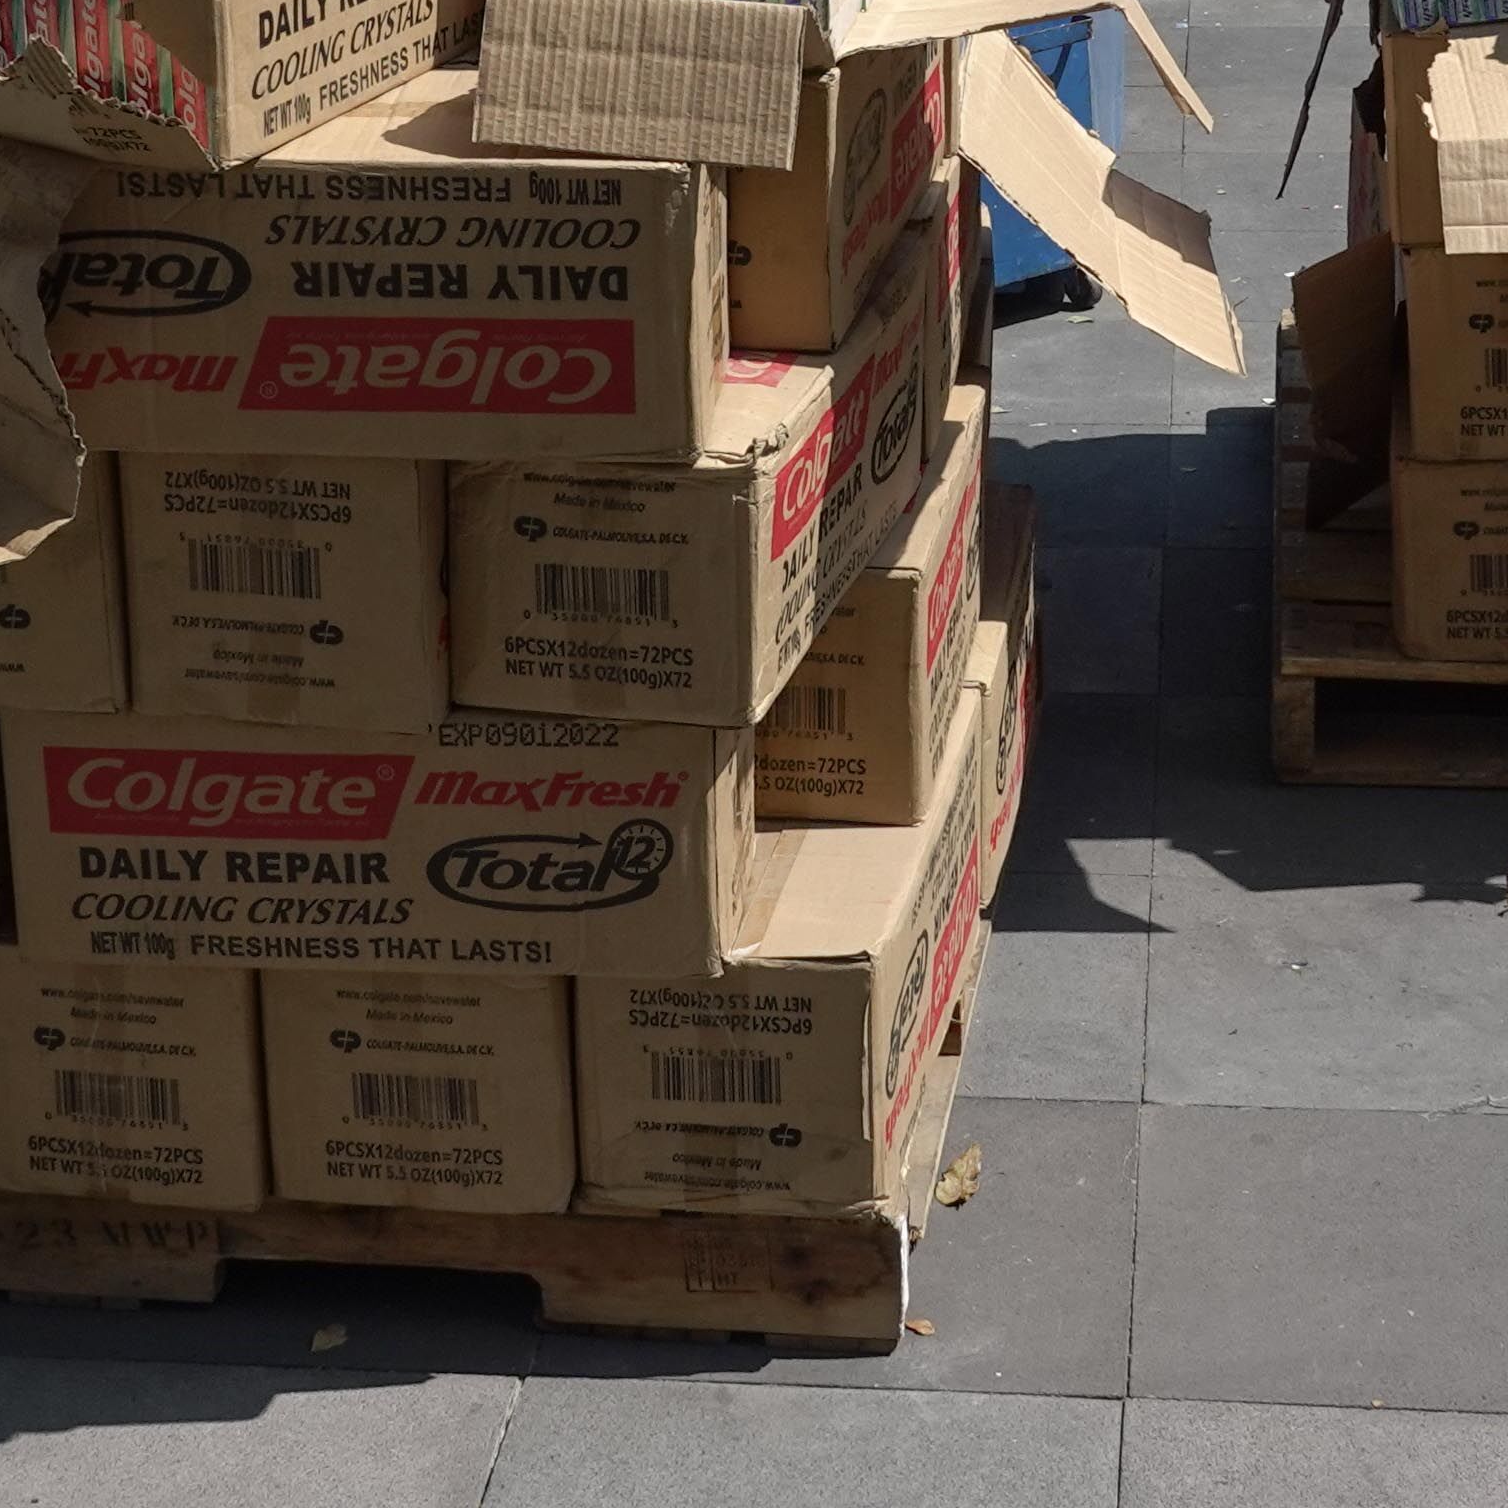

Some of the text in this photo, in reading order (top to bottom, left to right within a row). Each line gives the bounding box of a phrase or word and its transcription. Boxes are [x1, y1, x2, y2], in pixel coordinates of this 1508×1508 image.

[251, 32, 346, 100] COOLING
[264, 26, 449, 139] NET WT 100g FRESHNESS THAT
[115, 170, 622, 205] NET WT 100g FRESHNESS THAT LASTS!
[265, 214, 641, 249] COOLING CRYSTALS
[290, 261, 628, 302] DAILY REPAIR
[279, 327, 613, 405] Colgate
[292, 480, 350, 500] NET WT
[505, 636, 694, 666] 6PCSX12dozen=72PCS
[506, 659, 535, 676] NET
[539, 662, 564, 678] WT
[66, 755, 680, 828] Colgate MaxFresh
[79, 846, 390, 884] DAILY REPAIR
[451, 847, 619, 894] Total
[71, 892, 414, 927] COOLING CRYSTALS
[91, 931, 553, 964] NET WT 100g FRESHNESS THAT LASTS!
[755, 995, 812, 1013] NET WT
[327, 1161, 383, 1181] NET WT
